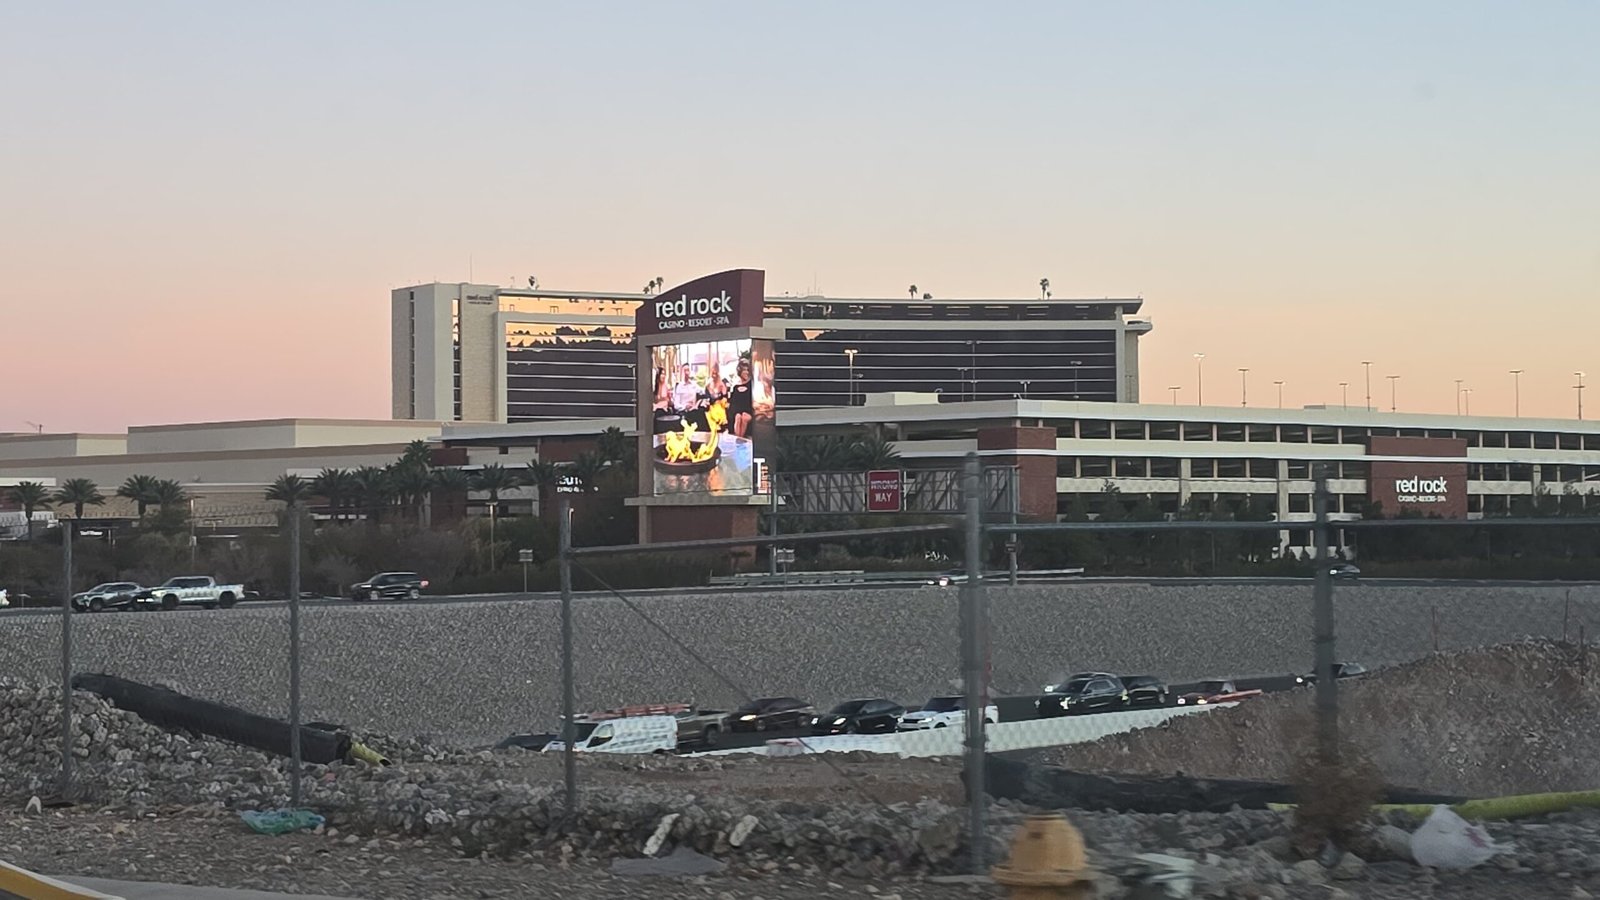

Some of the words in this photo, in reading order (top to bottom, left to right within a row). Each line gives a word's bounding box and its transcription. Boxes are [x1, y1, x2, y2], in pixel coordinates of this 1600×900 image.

[655, 294, 687, 318] red
[690, 290, 733, 315] rock
[659, 320, 685, 330] CASINO
[1395, 475, 1418, 493] red
[1419, 476, 1448, 493] rock
[875, 492, 892, 502] WAY
